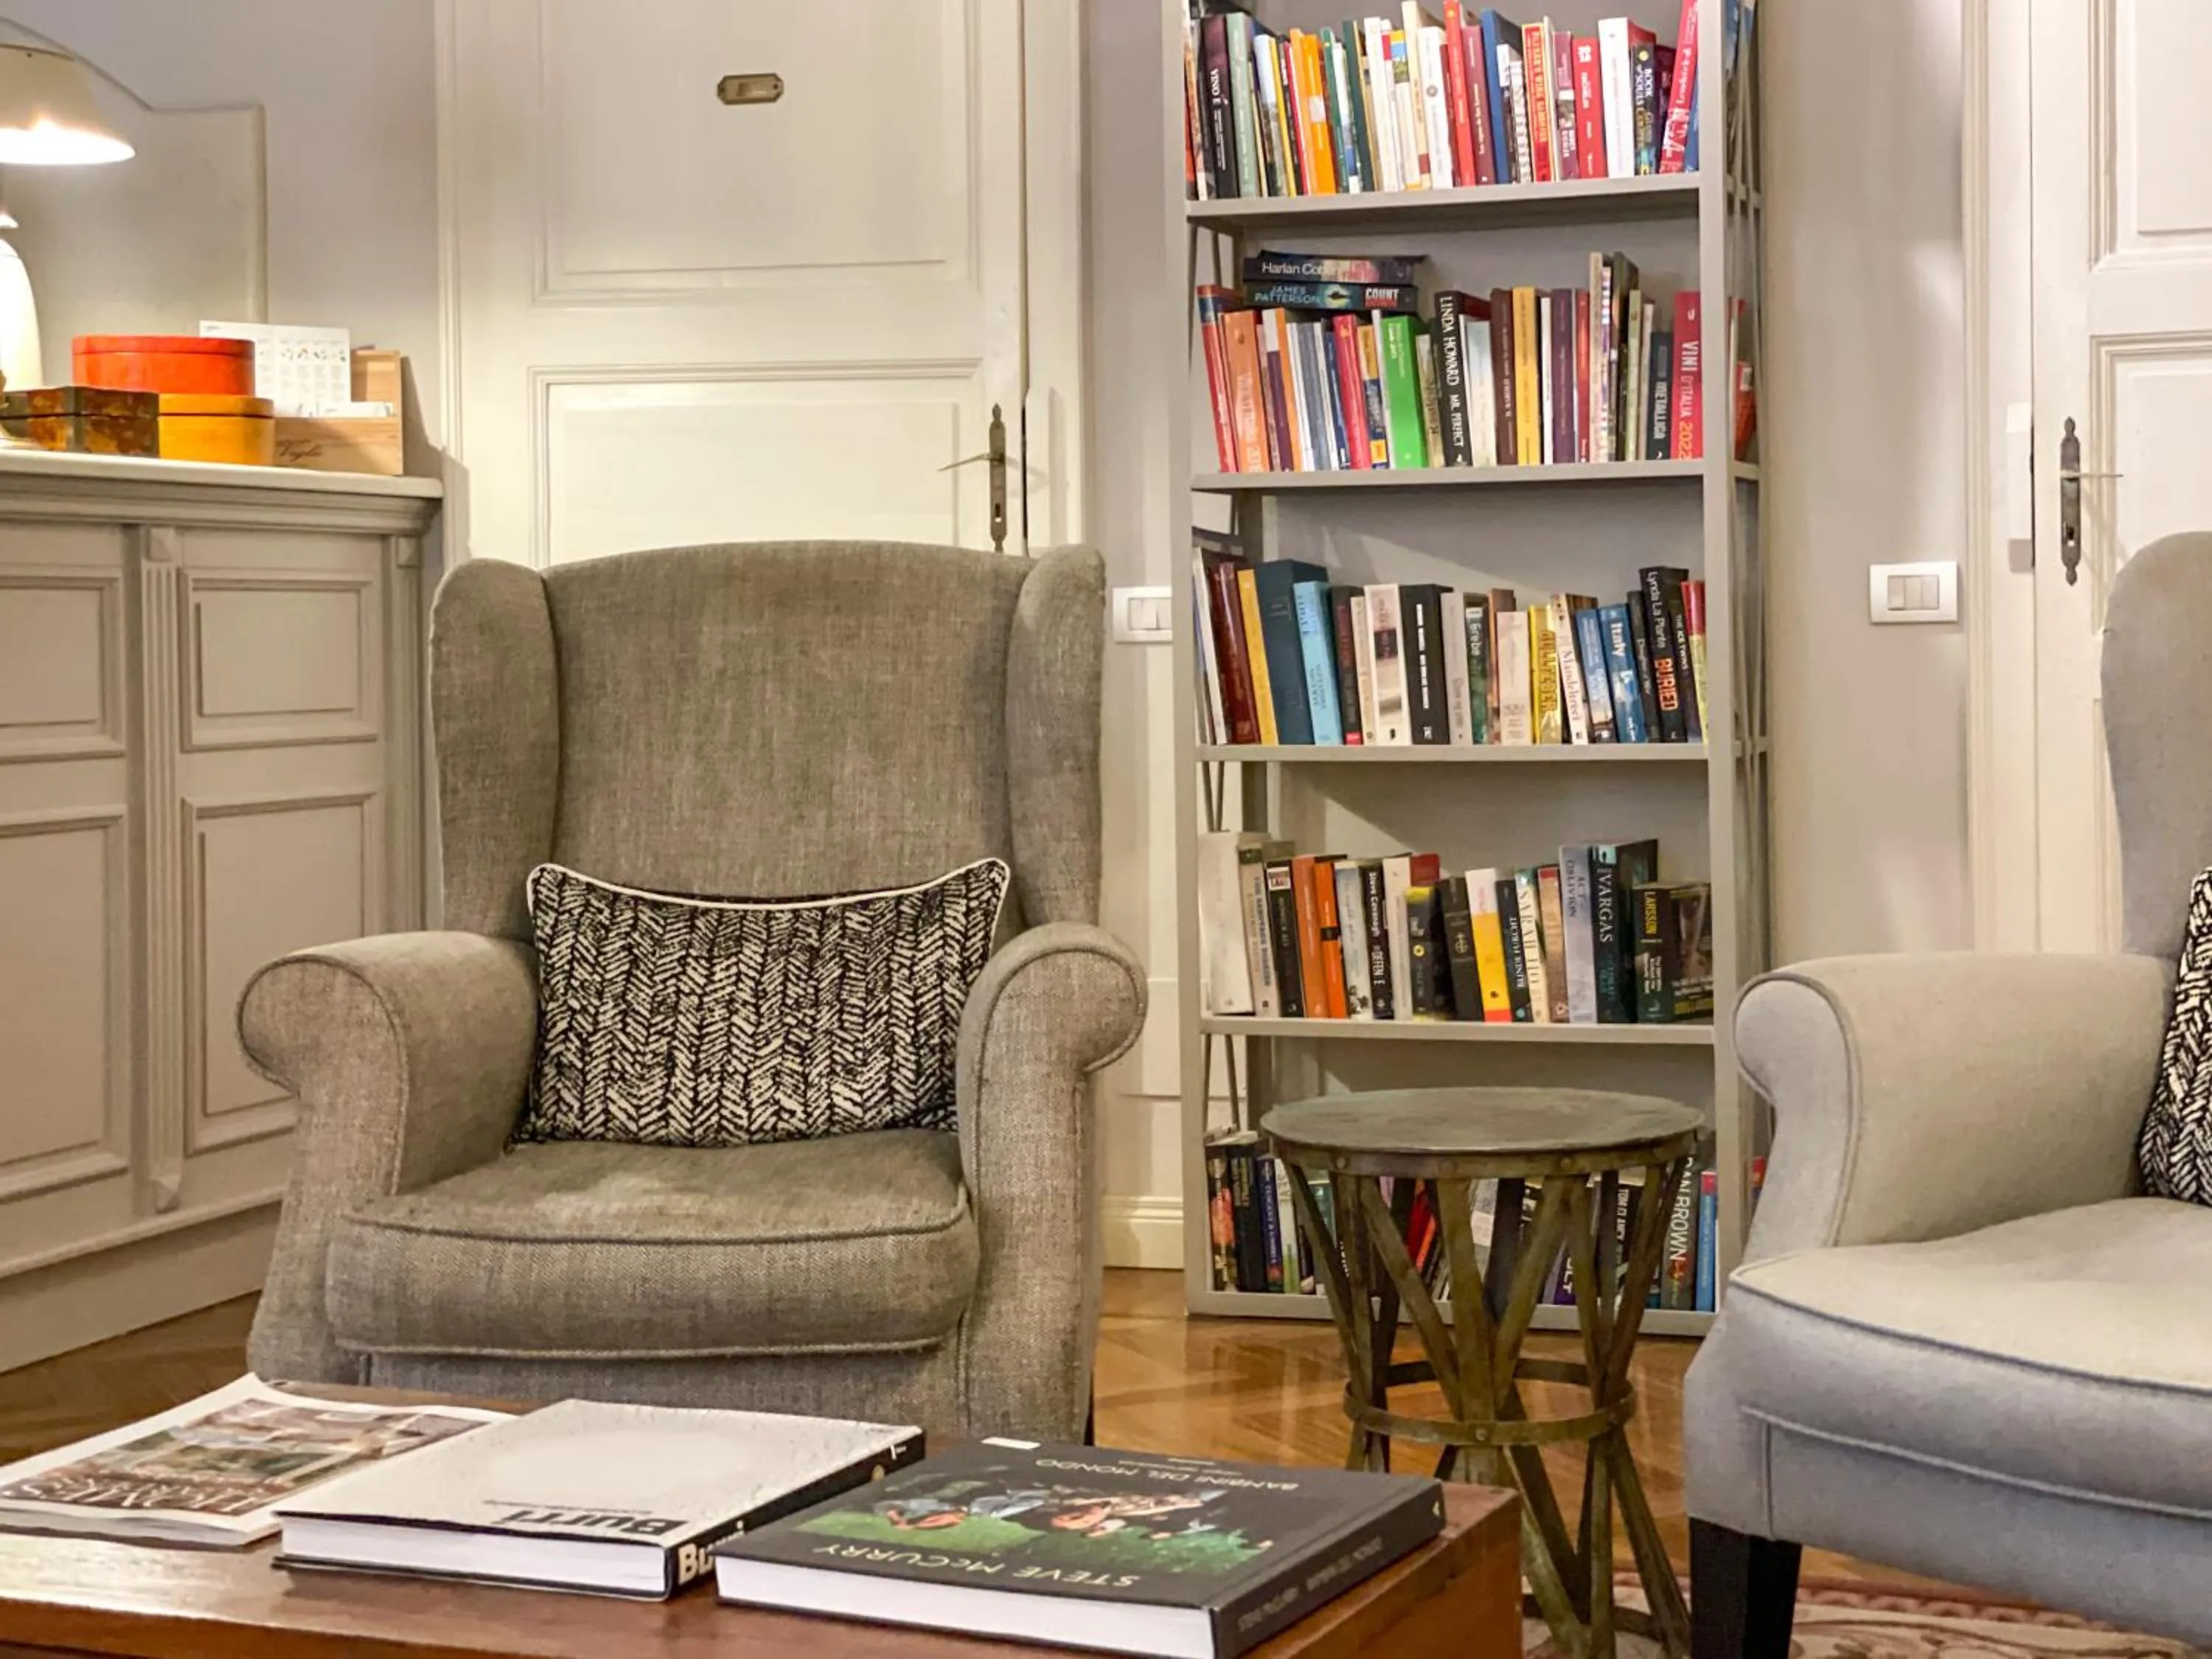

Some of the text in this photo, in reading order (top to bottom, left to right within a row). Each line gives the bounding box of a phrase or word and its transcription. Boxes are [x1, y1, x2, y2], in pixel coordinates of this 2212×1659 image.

[1644, 68, 1653, 97] BOOK
[1365, 288, 1399, 300] COUNT
[1439, 296, 1454, 333] LINDA
[1443, 336, 1460, 386] HOWARD
[1680, 340, 1699, 372] VINI
[1451, 412, 1464, 448] PERFECT
[1678, 421, 1693, 459] 2022
[1470, 622, 1481, 656] Grebe
[1610, 621, 1627, 658] Italy
[1647, 571, 1679, 711] Lynda La Plante BURIED
[1538, 630, 1559, 712] GULLFEBER
[1565, 859, 1577, 918] OBLIVION
[1517, 887, 1538, 949] SARAH
[1598, 873, 1613, 942] VARGAS
[1644, 891, 1658, 935] LARSSON
[1617, 1189, 1629, 1206] TOM
[1669, 1194, 1690, 1262] BROWN
[1034, 1458, 1142, 1476] MONDO
[492, 1510, 687, 1537] Burri
[811, 1541, 1141, 1588] STEVE McCURRY
